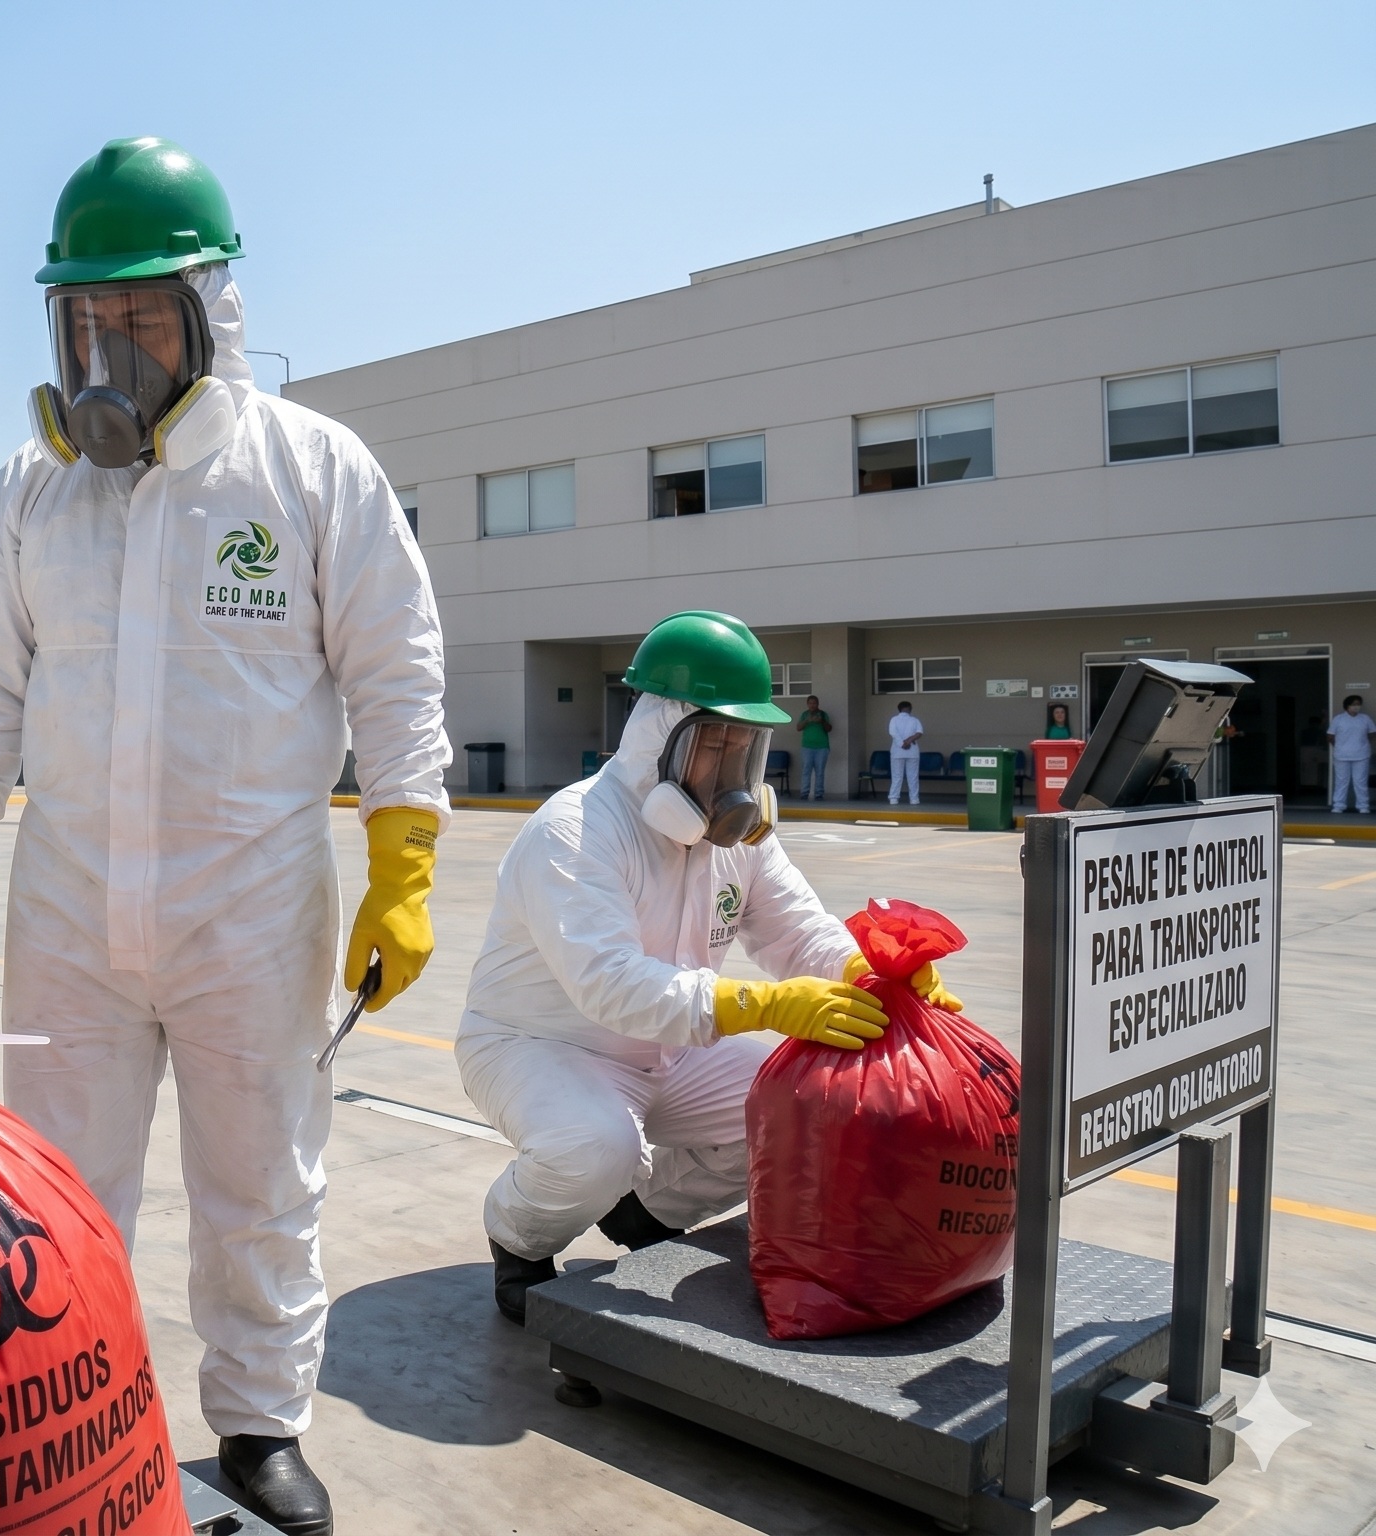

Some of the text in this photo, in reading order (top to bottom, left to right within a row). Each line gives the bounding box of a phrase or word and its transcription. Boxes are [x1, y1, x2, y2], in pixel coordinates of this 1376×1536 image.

[205, 605, 286, 621] CARE OF THE PLANET
[206, 585, 287, 608] ECO MBA
[1084, 834, 1268, 914] PESAJE DE CONTROL
[1091, 897, 1261, 986] PARA TRANSPORTE
[1109, 962, 1247, 1054] ESPECIALIZADO
[1080, 1044, 1262, 1159] REGISTRO OBLIGATORIO
